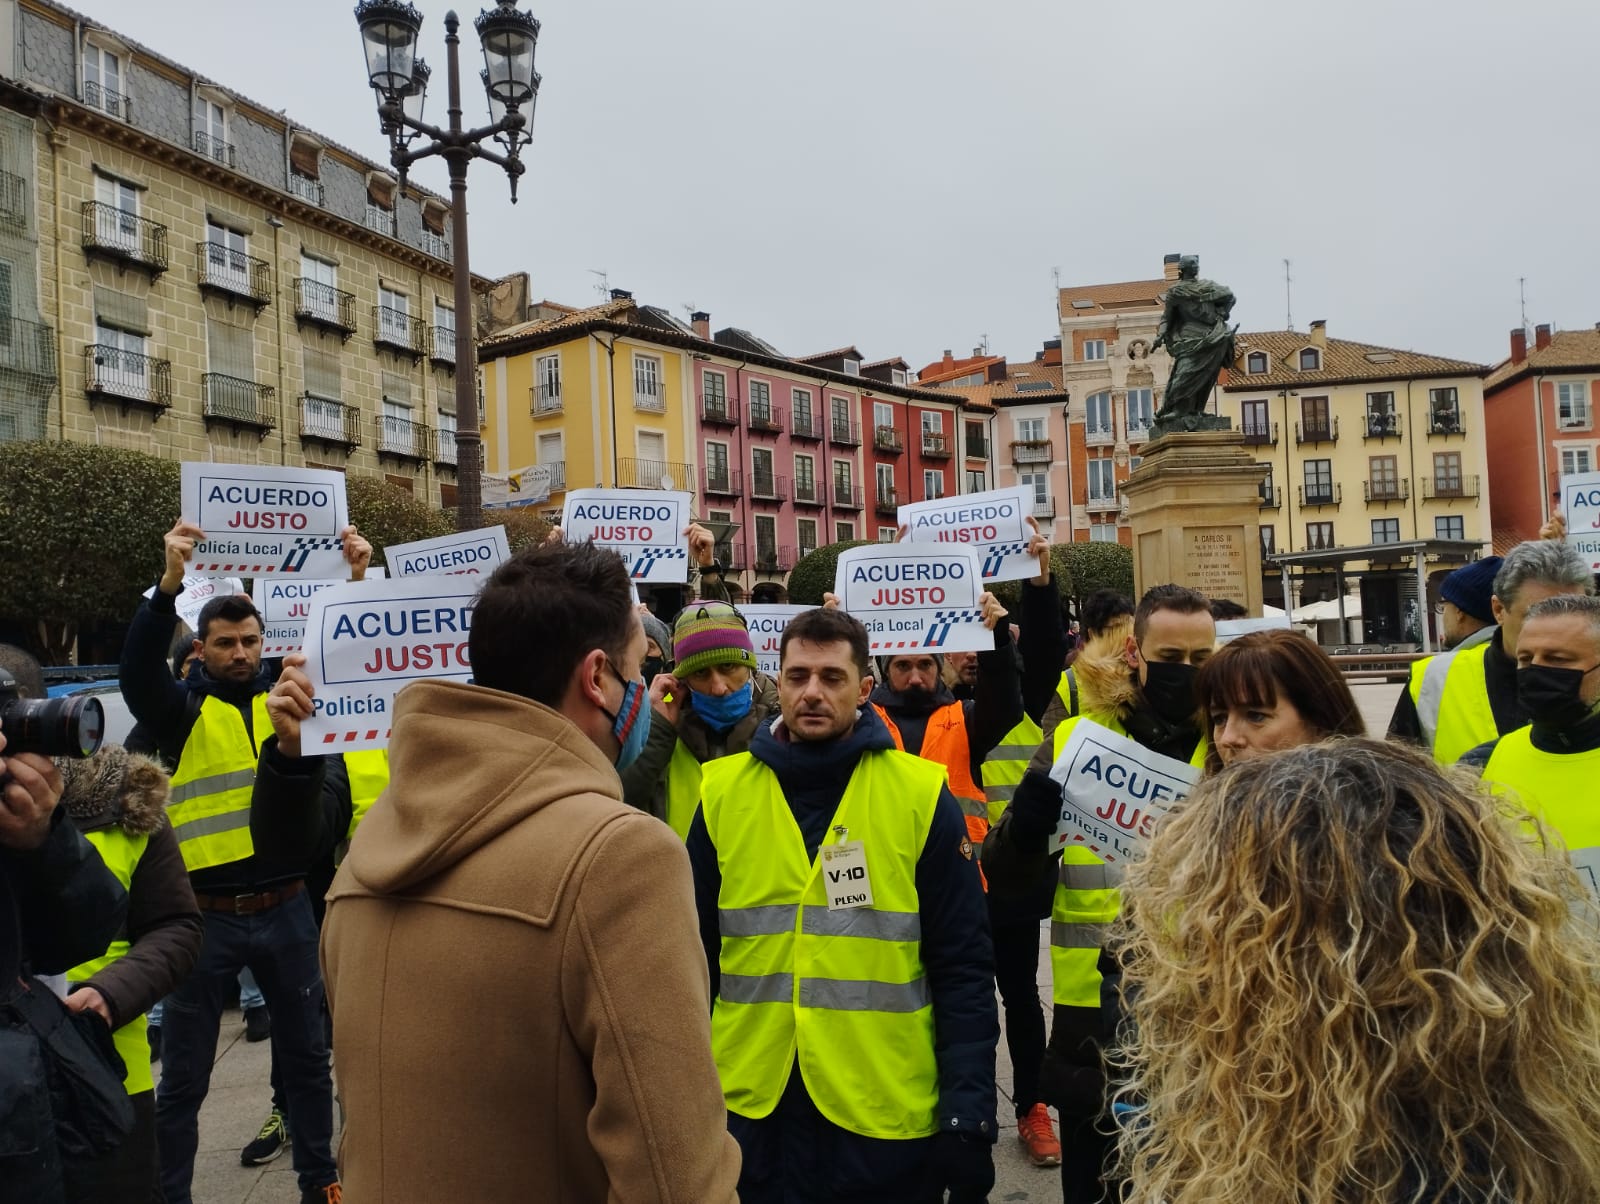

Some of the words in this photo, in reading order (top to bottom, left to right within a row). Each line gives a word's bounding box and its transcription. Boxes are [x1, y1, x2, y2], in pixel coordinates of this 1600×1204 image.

[208, 486, 328, 508] ACUERDO
[228, 511, 307, 530] JUSTO
[574, 505, 671, 521] ACUERDO
[917, 505, 1013, 528] ACUERDO
[591, 525, 653, 541] JUSTO
[245, 542, 283, 555] Local
[404, 546, 492, 574] ACUERDO
[853, 563, 964, 583] ACUERDO
[872, 587, 945, 606] JUSTO
[332, 607, 473, 640] ACUERD
[889, 618, 923, 632] Local
[312, 693, 385, 717] Policía
[1062, 810, 1108, 844] olicía
[828, 866, 865, 883] V-10
[835, 893, 866, 906] PLENO
